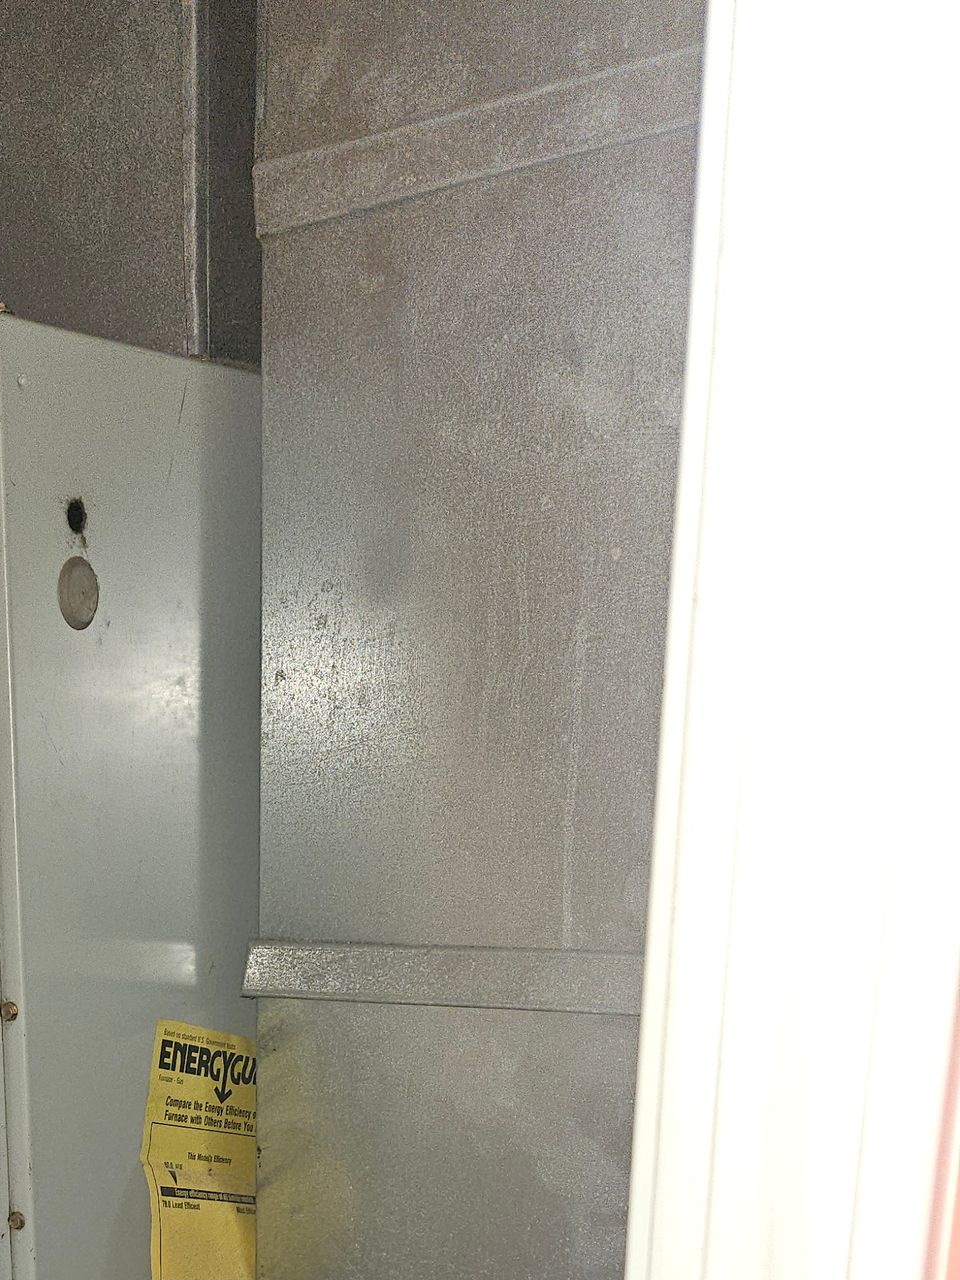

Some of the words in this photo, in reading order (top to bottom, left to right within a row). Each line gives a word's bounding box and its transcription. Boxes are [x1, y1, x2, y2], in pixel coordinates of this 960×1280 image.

[159, 1039, 256, 1089] ENERGYGU
[166, 1096, 192, 1110] Compare
[194, 1100, 203, 1111] the
[205, 1102, 224, 1116] Energy
[226, 1105, 251, 1120] Efficiency
[164, 1110, 188, 1123] Furnace
[190, 1114, 202, 1124] with
[204, 1116, 222, 1128] Others
[224, 1119, 241, 1130] Before
[244, 1121, 253, 1132] You
[188, 1152, 196, 1160] This
[214, 1155, 232, 1166] Efficiency
